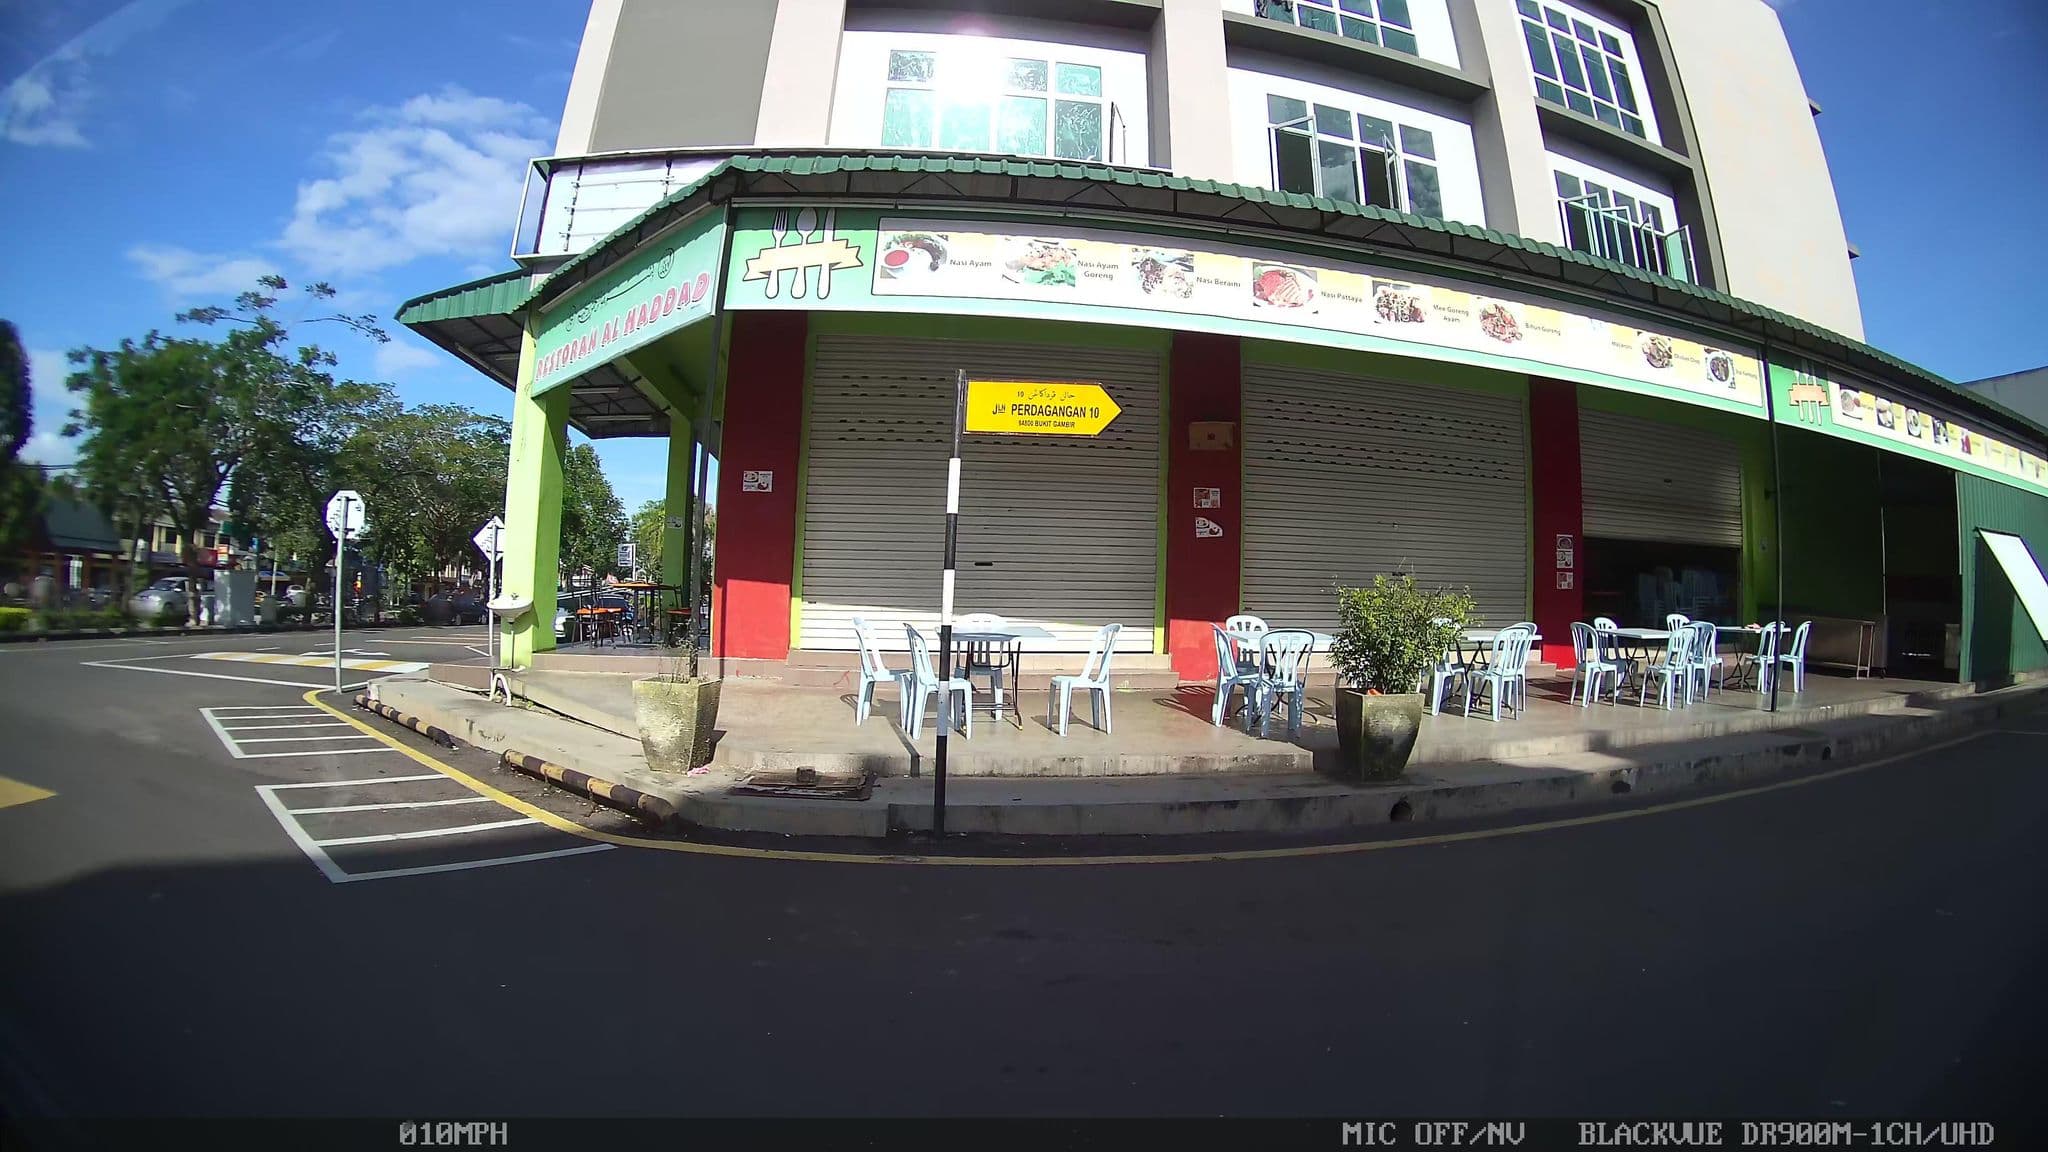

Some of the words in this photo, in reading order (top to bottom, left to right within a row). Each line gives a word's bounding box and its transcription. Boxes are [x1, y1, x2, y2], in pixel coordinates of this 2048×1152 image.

[949, 258, 967, 266] Nasi
[968, 260, 992, 268] Ayam
[1077, 260, 1095, 268] Nasi
[1096, 261, 1119, 270] Ayam
[1083, 270, 1114, 281] Goreng
[1196, 276, 1213, 284] Nasi
[536, 331, 599, 381] RESTORAN
[601, 317, 620, 348] AL
[624, 272, 710, 336] HADDAD
[1011, 403, 1087, 418] PERDAGANGAN
[1088, 406, 1099, 418] 10
[1052, 420, 1075, 428] GAMBIR
